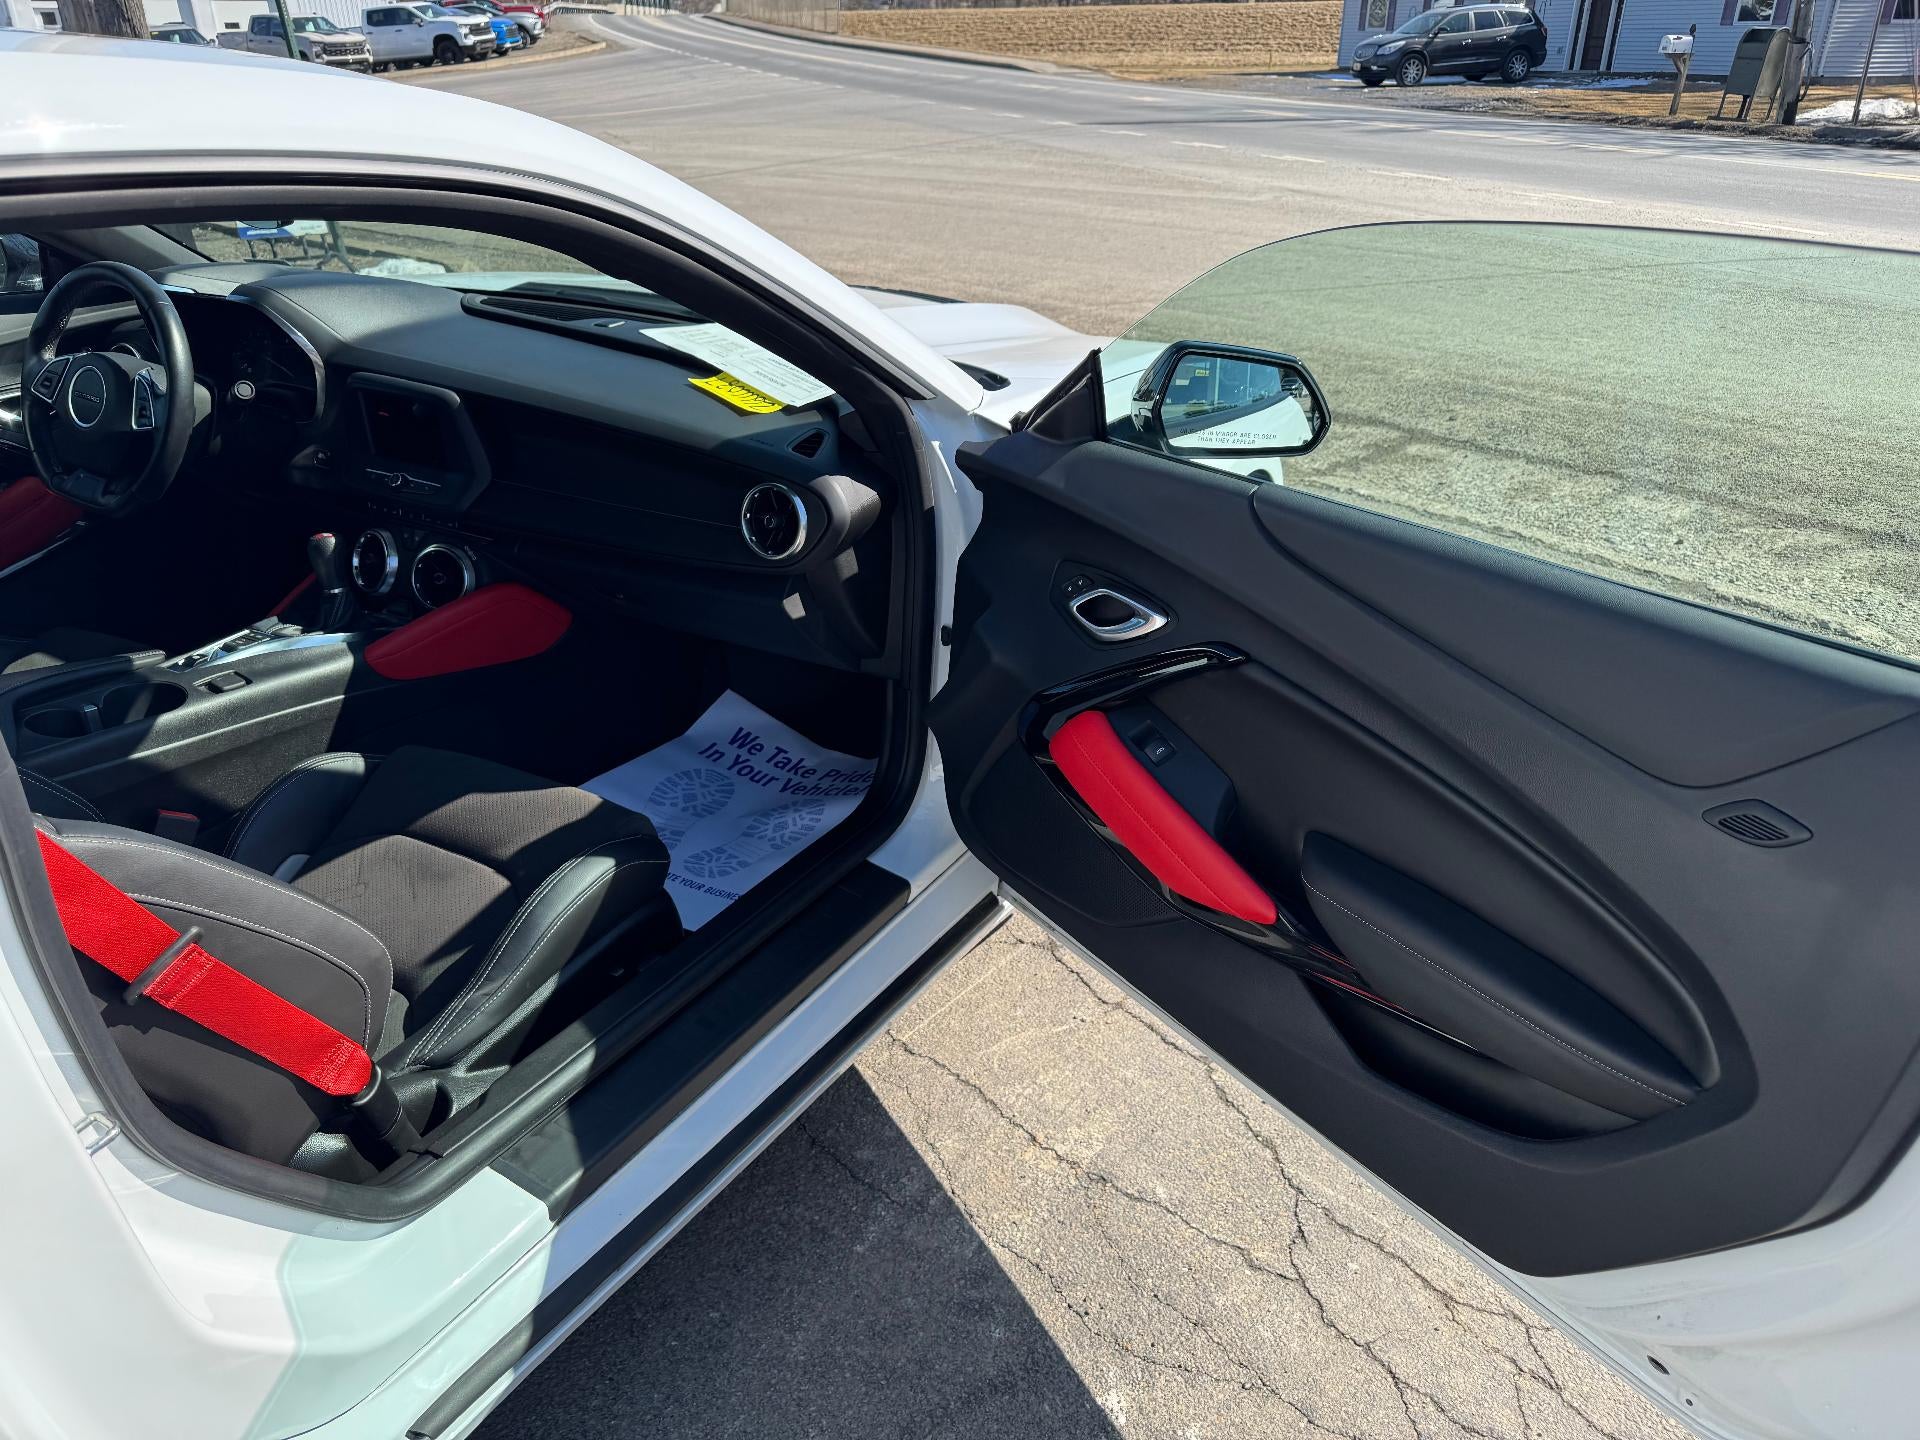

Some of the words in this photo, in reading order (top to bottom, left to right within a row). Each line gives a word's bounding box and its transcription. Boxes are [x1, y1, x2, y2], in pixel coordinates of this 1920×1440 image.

[698, 742, 725, 762] In
[727, 754, 779, 787] Your
[728, 726, 764, 756] We
[766, 746, 817, 778] Take
[818, 768, 876, 783] Pride
[679, 877, 706, 891] YOUR
